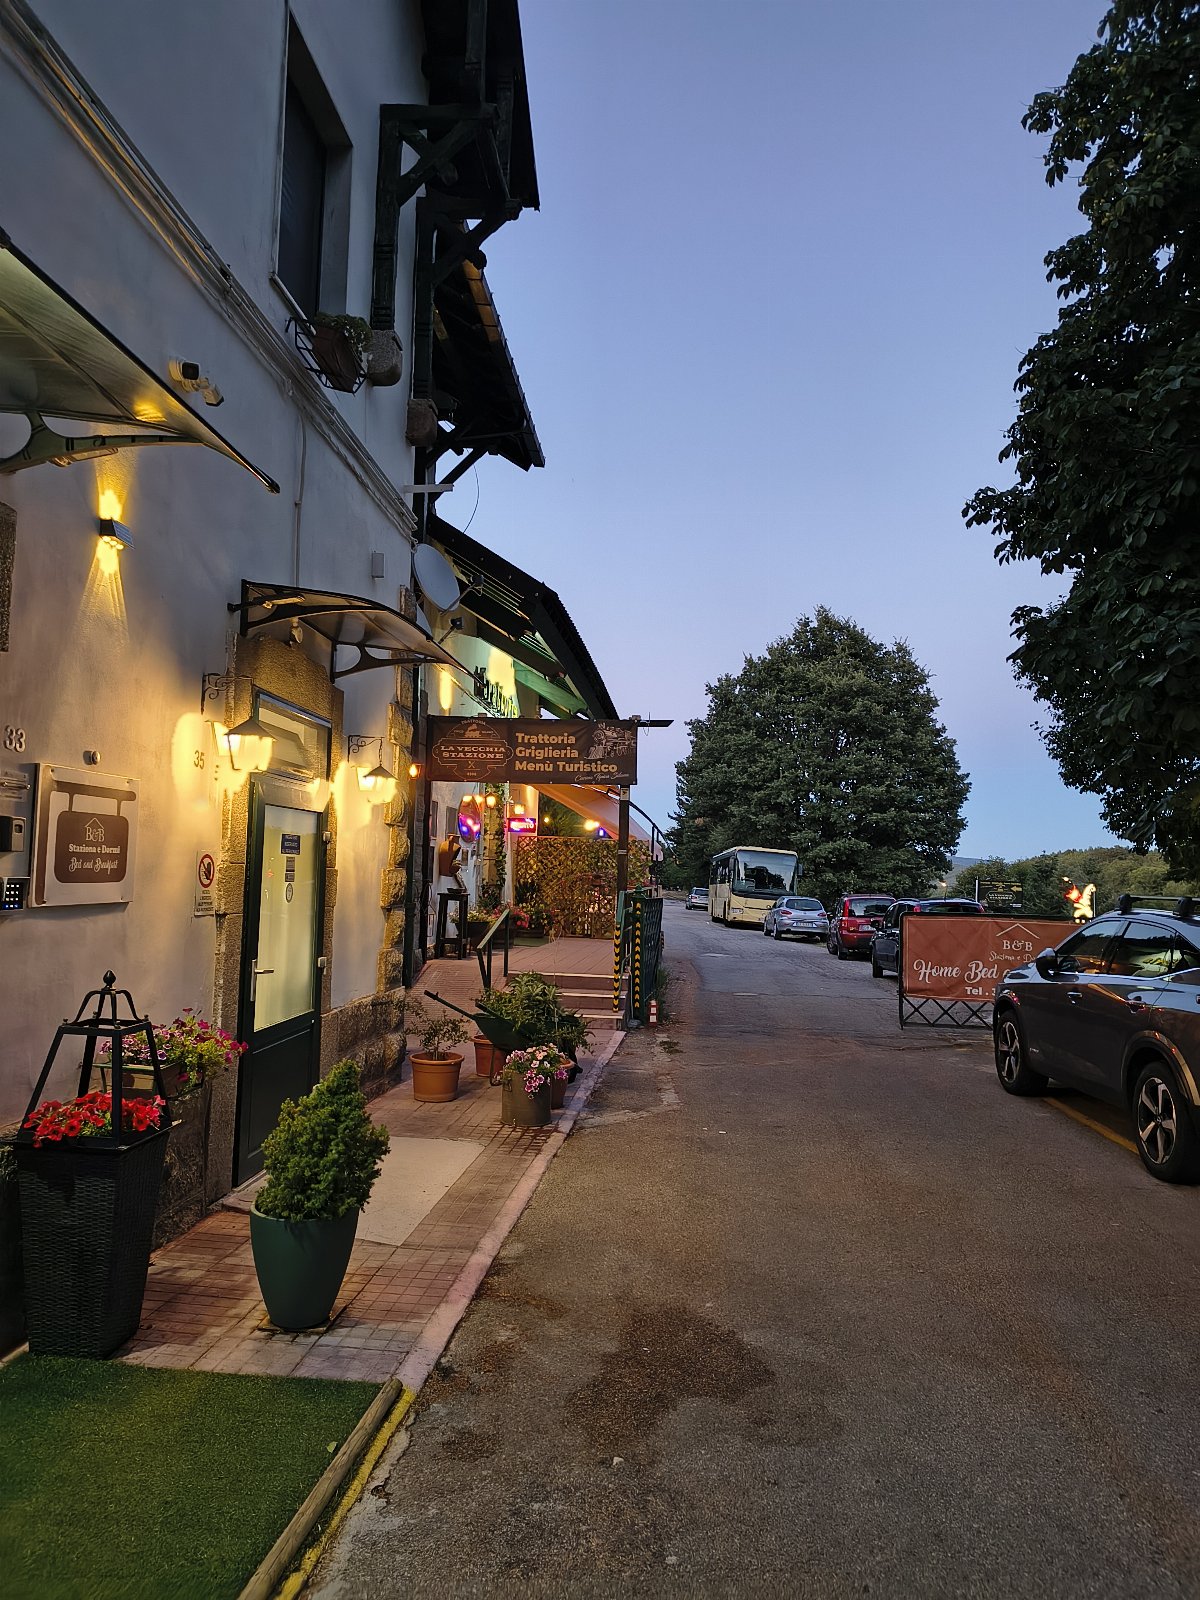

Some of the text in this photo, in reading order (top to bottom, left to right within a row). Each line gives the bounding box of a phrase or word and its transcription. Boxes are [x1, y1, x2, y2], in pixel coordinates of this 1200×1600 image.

[4, 725, 26, 752] 33
[515, 733, 576, 744] Trattoria
[193, 749, 205, 770] 35
[515, 746, 579, 760] Griglieria
[514, 761, 618, 772] Menù Turistico
[85, 826, 105, 842] B&B
[68, 843, 97, 853] Staziona
[101, 845, 121, 854] Dormi
[68, 857, 82, 872] Bed
[1003, 939, 1033, 951] B&B
[913, 959, 999, 984] Home Bed
